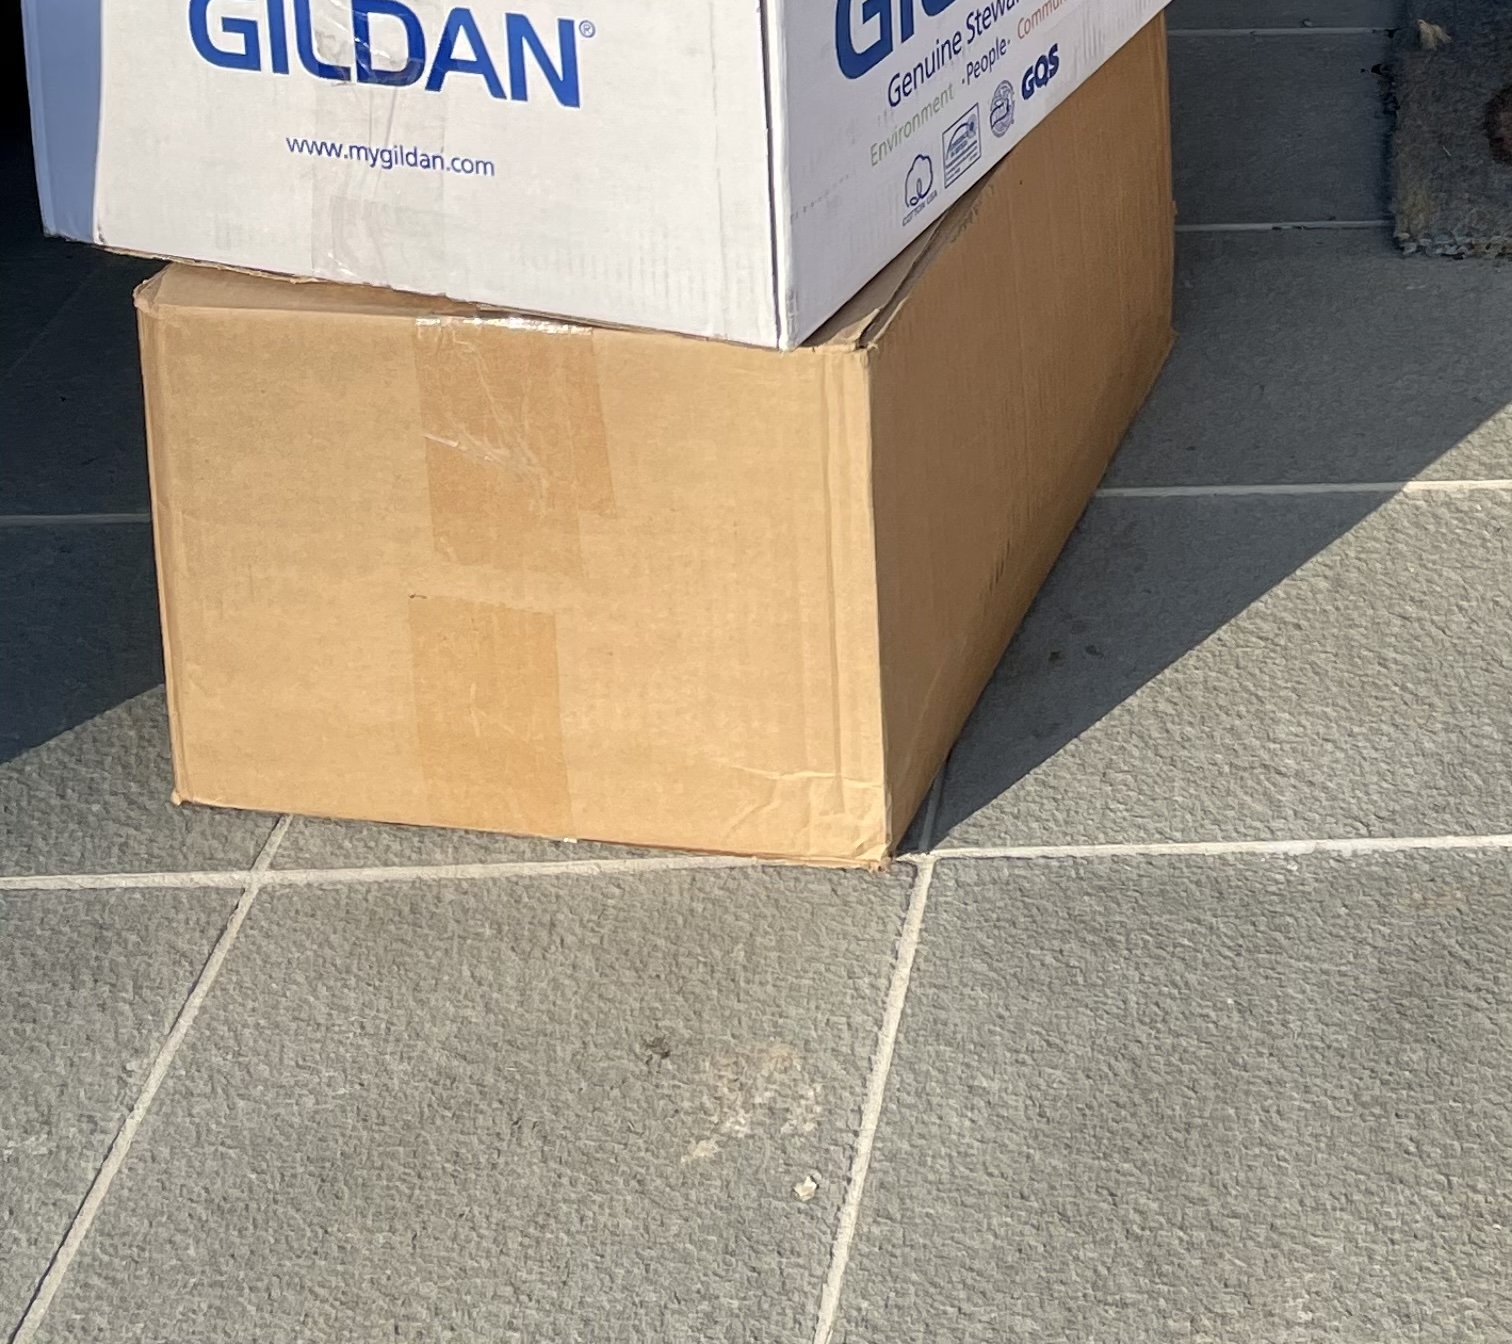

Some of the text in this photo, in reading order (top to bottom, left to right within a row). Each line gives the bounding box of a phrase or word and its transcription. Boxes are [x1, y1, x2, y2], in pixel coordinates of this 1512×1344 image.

[887, 33, 962, 107] Genuine
[286, 136, 495, 177] www.mygildan.com
[869, 83, 955, 167] Environment
